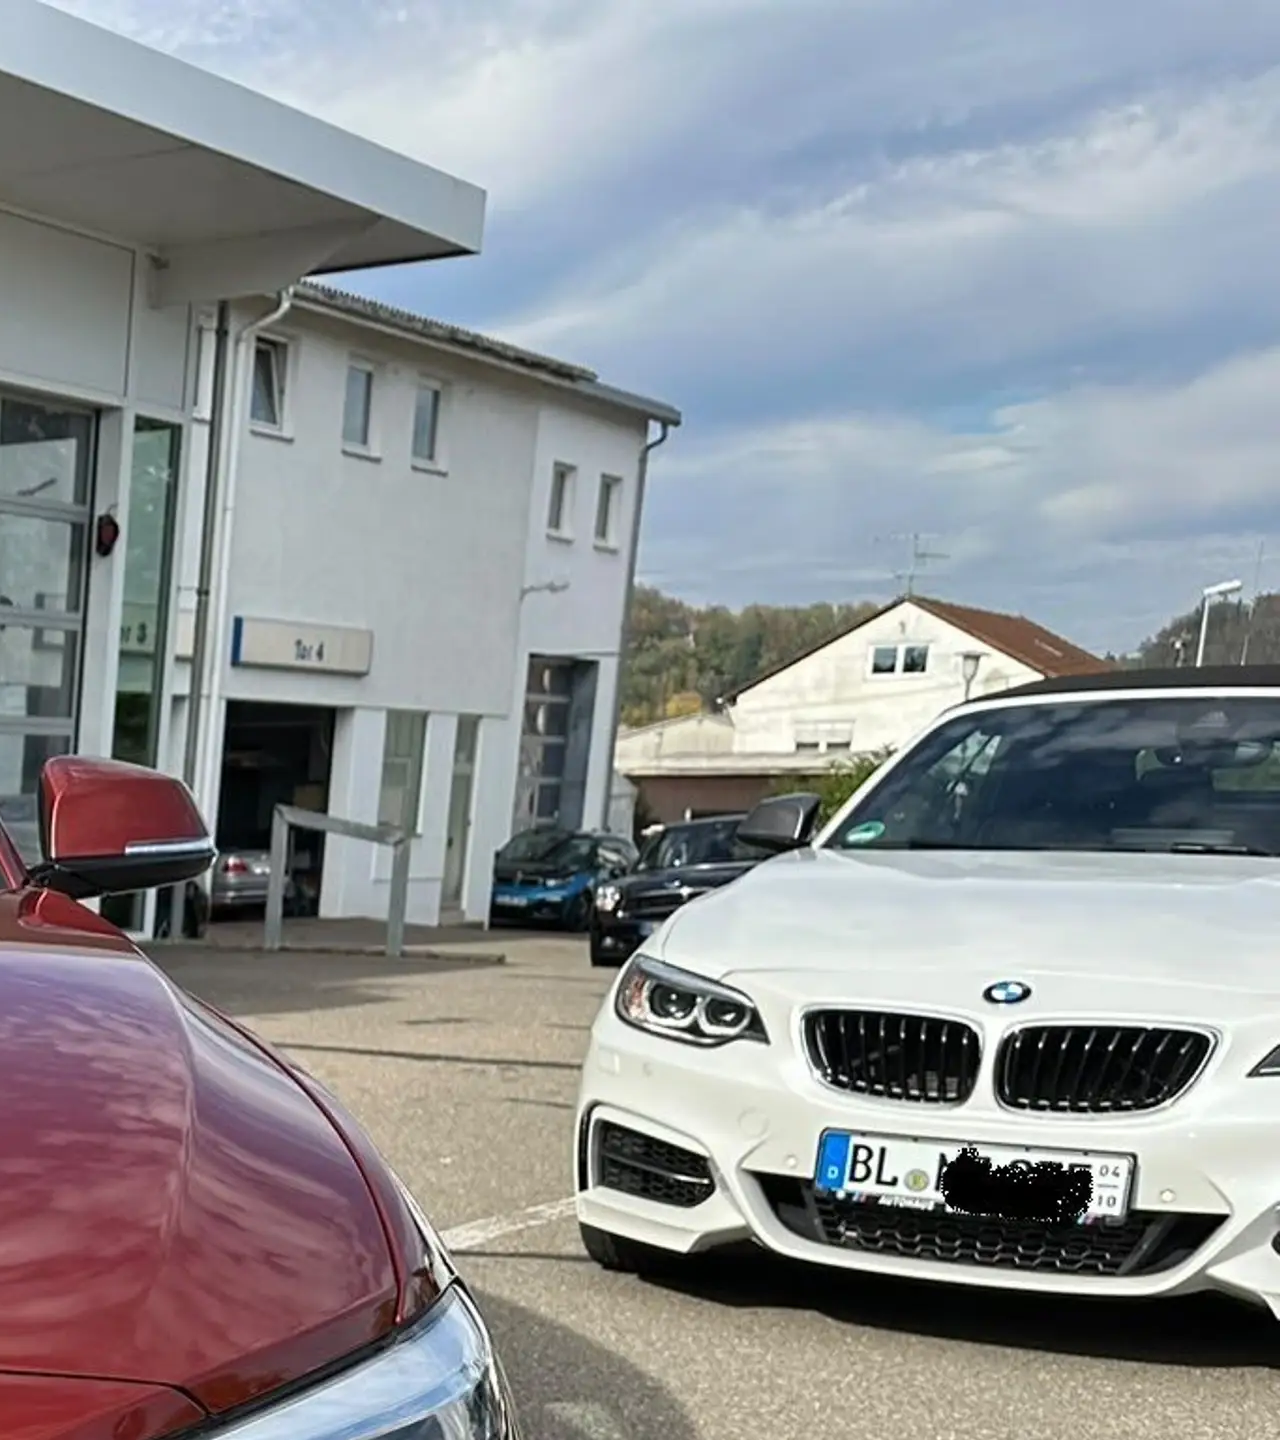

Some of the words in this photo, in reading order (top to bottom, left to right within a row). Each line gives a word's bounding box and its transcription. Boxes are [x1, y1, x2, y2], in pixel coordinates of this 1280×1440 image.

[849, 1144, 898, 1186] BL
[1099, 1164, 1120, 1178] 04
[1098, 1195, 1116, 1207] 10
